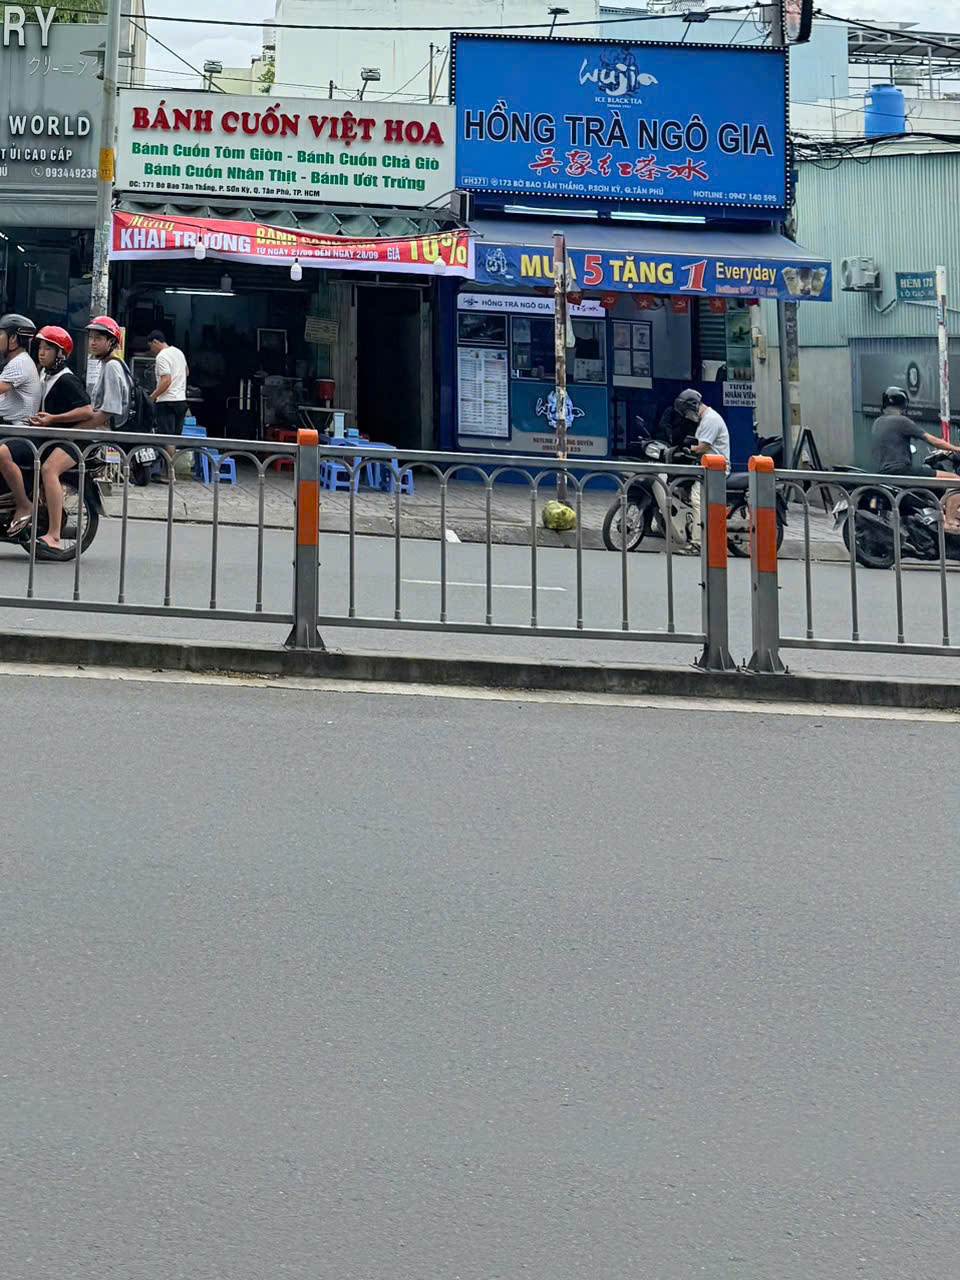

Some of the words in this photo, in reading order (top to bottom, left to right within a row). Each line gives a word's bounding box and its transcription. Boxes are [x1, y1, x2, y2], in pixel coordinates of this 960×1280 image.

[9, 115, 91, 136] WORLD
[132, 100, 213, 132] BÁNH
[221, 102, 300, 136] CUỐN
[308, 111, 376, 147] VIỆT
[384, 120, 444, 145] HOA
[464, 99, 556, 144] HỒNG
[564, 110, 630, 148] TRÀ
[638, 114, 708, 153] NGÔ
[717, 122, 774, 156] GIA
[10, 143, 21, 160] ỦI
[25, 149, 46, 160] CAO
[50, 146, 72, 161] CẤP
[132, 142, 168, 156] Bánh
[173, 143, 210, 157] Cuốn
[214, 146, 245, 159] Tôm
[250, 147, 282, 161] Giòn
[297, 151, 334, 164] Bánh
[340, 152, 377, 167] Cuốn
[382, 155, 410, 169] Chả
[415, 157, 440, 170] Giò
[144, 163, 181, 177] Bánh
[186, 164, 222, 179] Cuốn
[227, 166, 264, 181] Nhân
[269, 168, 297, 184] Thịt
[311, 172, 348, 185] Bánh
[353, 172, 378, 187] Ướt
[382, 176, 425, 191] Trứng
[499, 179, 512, 187] 173
[513, 178, 524, 187] BỜ
[525, 180, 541, 188] BAO
[542, 180, 557, 189] TÂN
[559, 180, 587, 192] THẮNG,
[611, 185, 623, 194] KỲ,
[649, 186, 664, 195] PHÚ
[156, 181, 165, 189] Bờ
[182, 182, 193, 190] Tân
[195, 182, 217, 192] Thắng,
[241, 186, 252, 194] Kỳ,
[262, 187, 275, 195] Tân
[693, 190, 723, 199] HOTLINE
[729, 192, 746, 200] 0947
[120, 227, 166, 249] KHAI
[172, 231, 252, 252] TRƯƠNG
[356, 251, 379, 259] 28/09
[583, 254, 604, 286] 5
[609, 256, 674, 289] TẶNG
[680, 260, 708, 292] 1
[715, 262, 776, 285] Everyday
[521, 301, 536, 309] NGÔ
